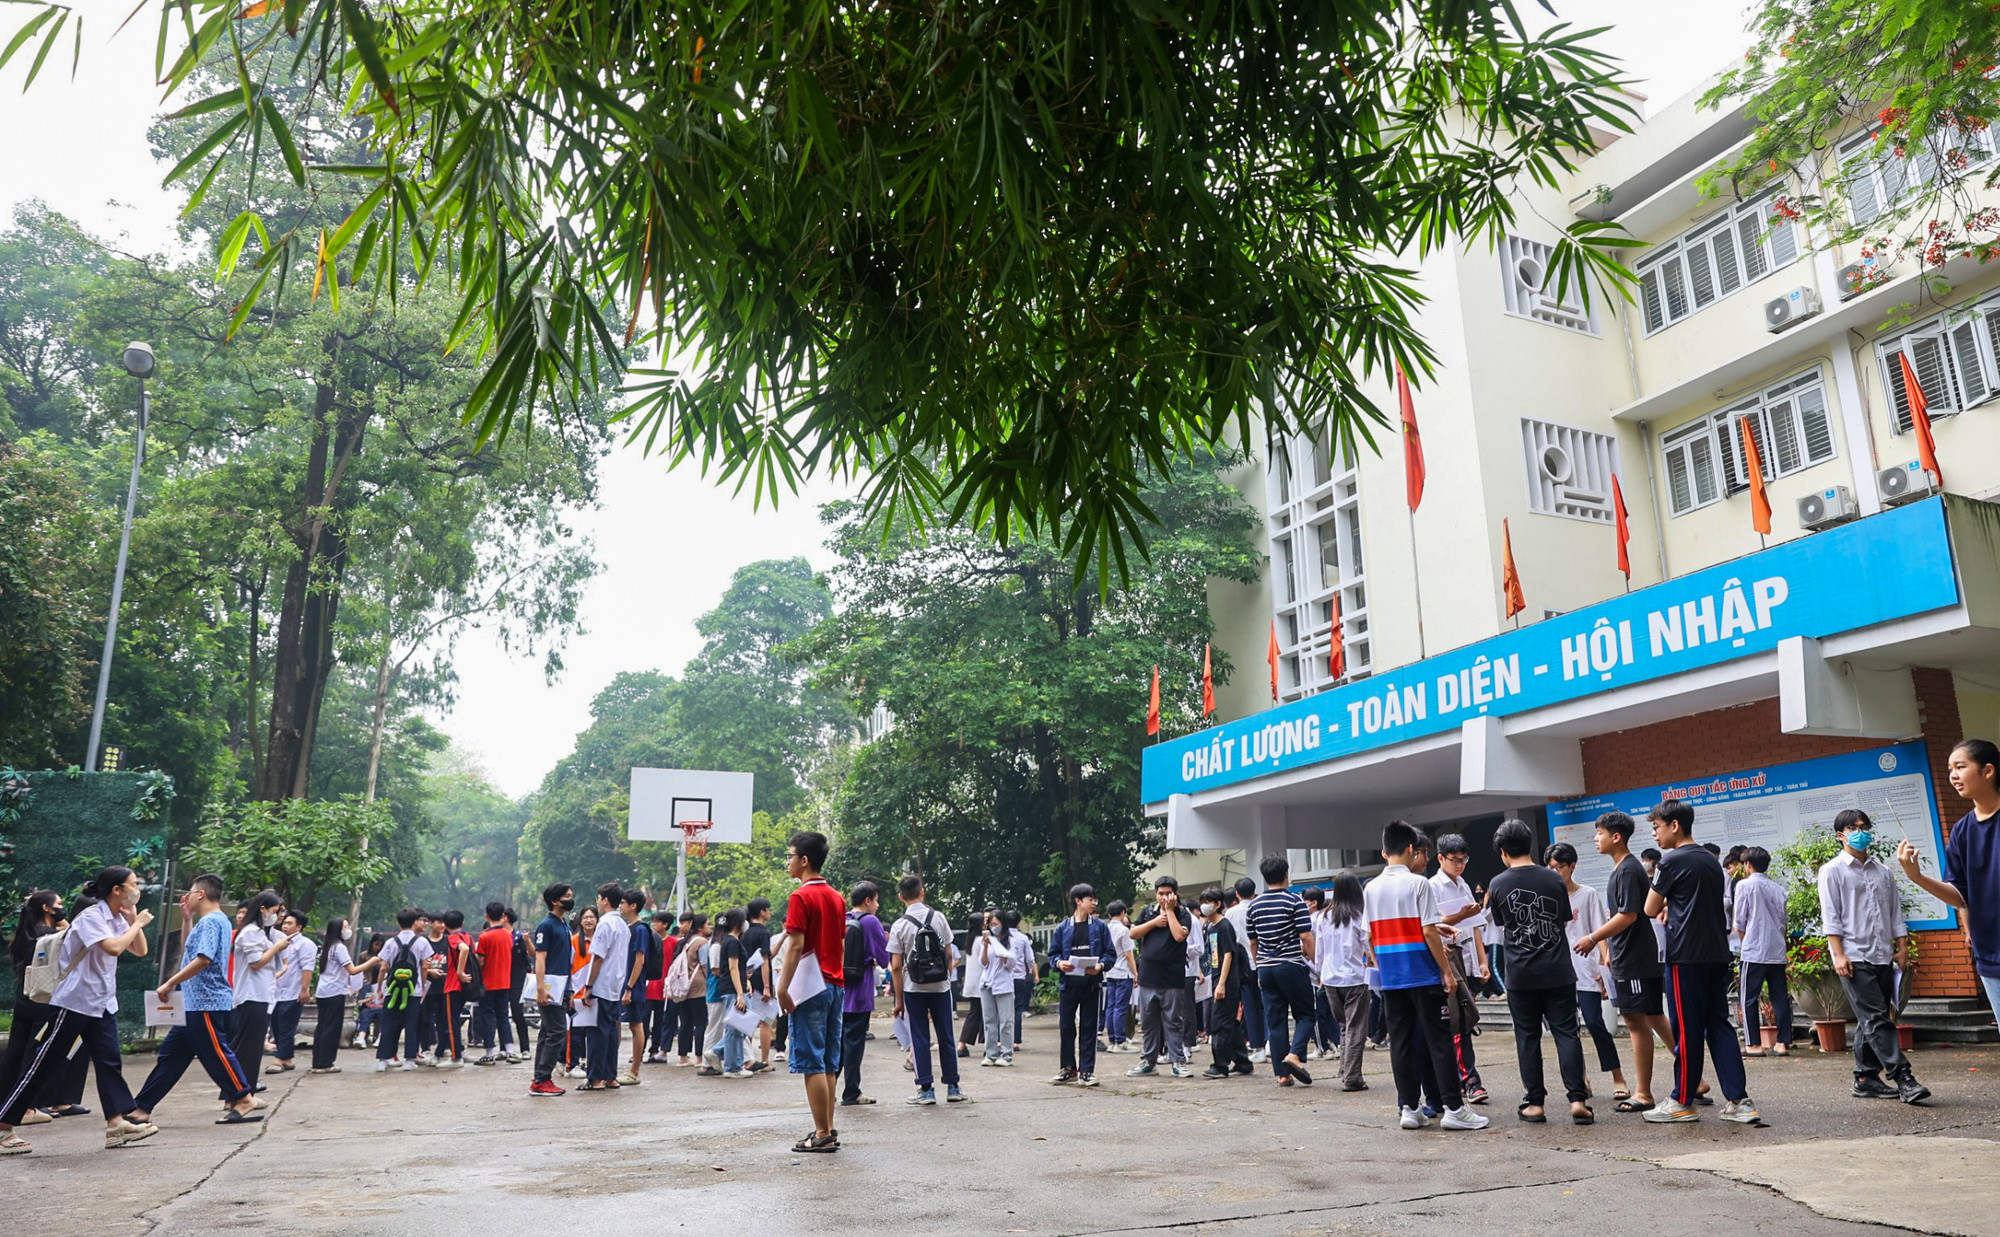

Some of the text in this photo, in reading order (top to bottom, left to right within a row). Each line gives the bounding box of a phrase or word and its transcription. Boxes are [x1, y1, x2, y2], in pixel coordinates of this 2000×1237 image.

[1181, 730, 1235, 782] CHẤT
[1240, 713, 1320, 766] LƯỢNG
[1346, 683, 1427, 738] TOÀN
[1436, 653, 1521, 715] DIỆN
[1560, 616, 1634, 681] HỘI
[1647, 575, 1789, 658] NHẬP
[1662, 772, 1766, 801] BẢNG QUY TẮC ỨNG XỬ
[536, 932, 544, 944] 3
